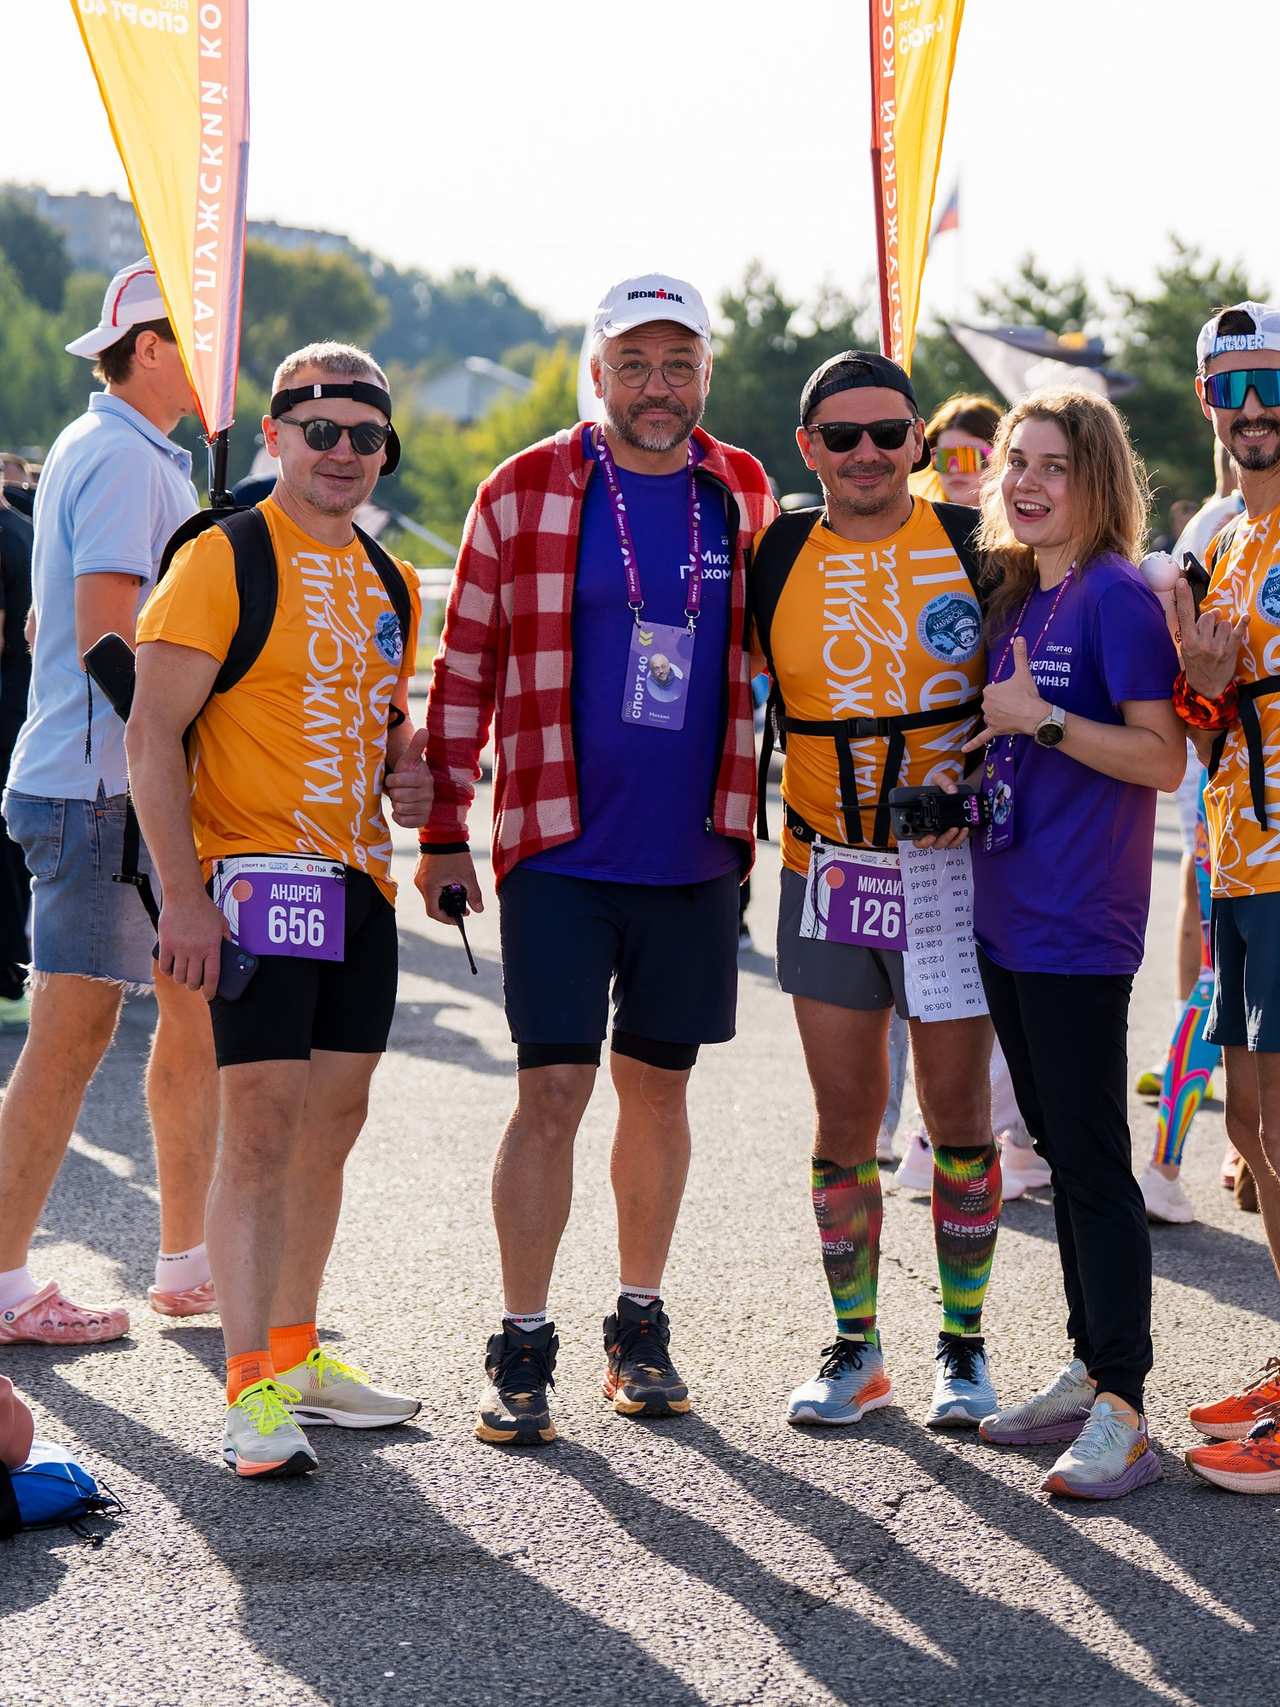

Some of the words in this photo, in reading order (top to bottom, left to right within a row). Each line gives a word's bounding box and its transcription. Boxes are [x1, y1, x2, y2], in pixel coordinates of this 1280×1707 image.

[628, 289, 685, 304] IRONMAN
[292, 552, 344, 804] КАЛУЖСКИЙ
[632, 674, 646, 719] СПОРТ
[639, 656, 648, 672] 40
[270, 883, 322, 903] АНДРЕЙ
[857, 875, 904, 896] МИХАИ
[268, 905, 325, 947] 656
